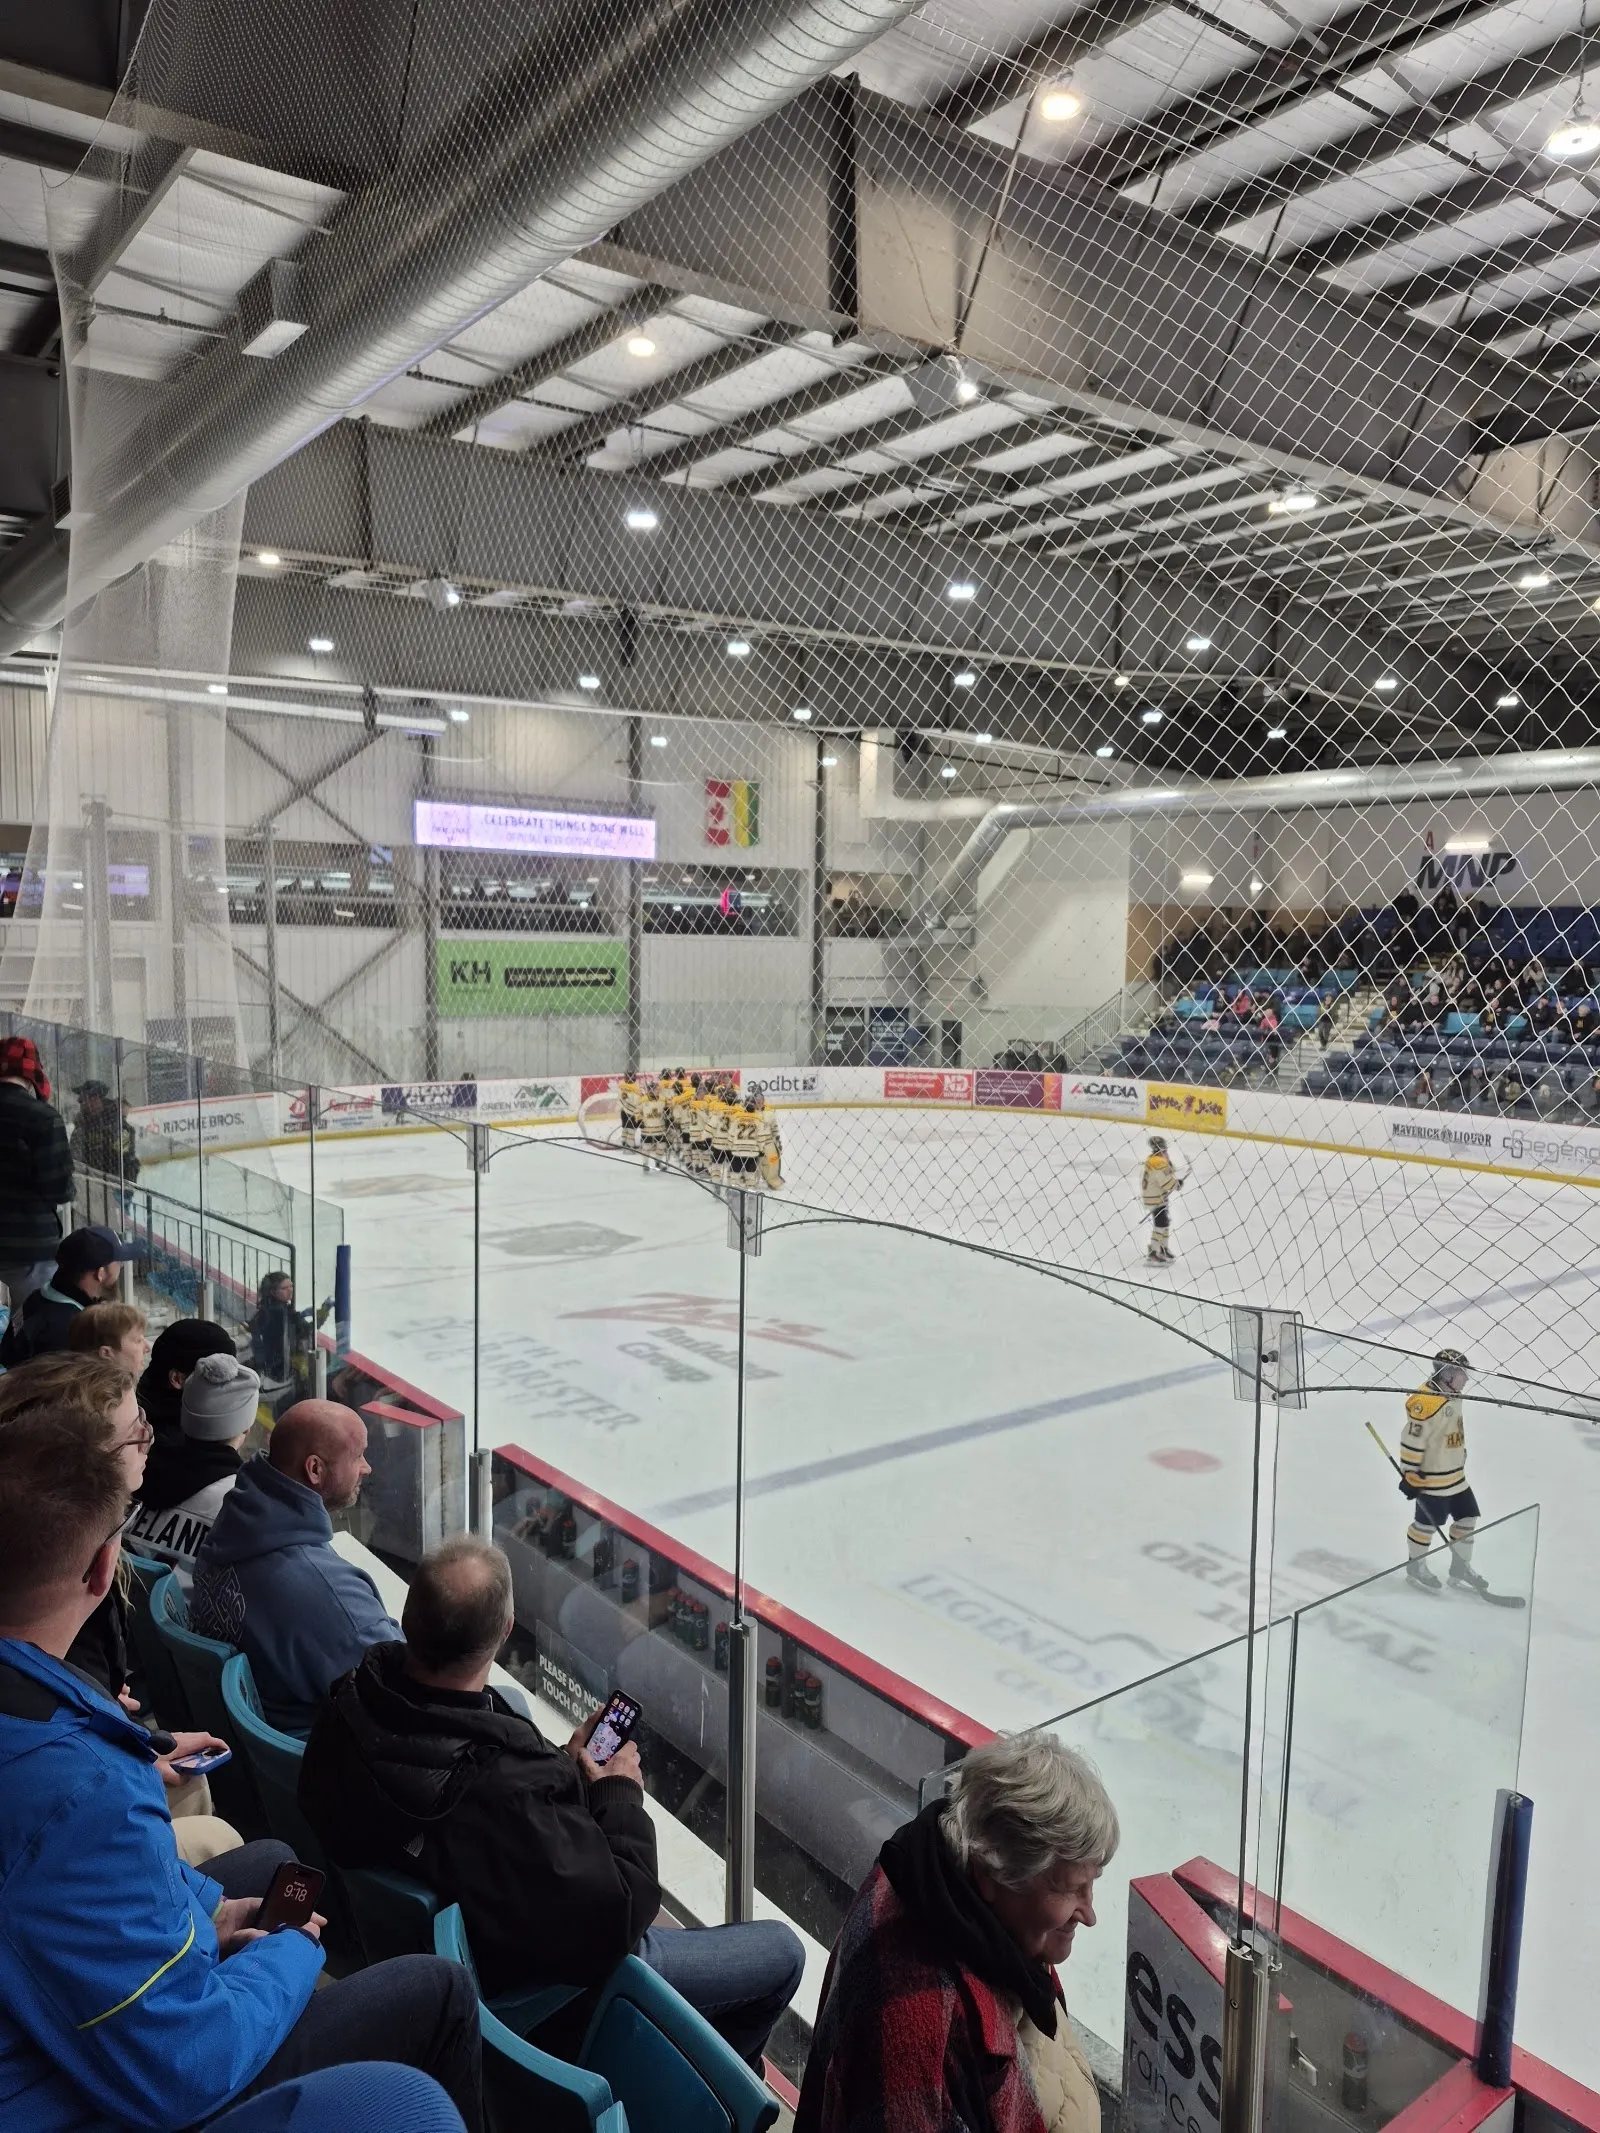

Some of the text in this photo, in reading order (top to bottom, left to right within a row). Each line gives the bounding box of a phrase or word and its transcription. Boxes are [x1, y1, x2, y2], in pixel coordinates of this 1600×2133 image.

[1415, 852, 1517, 889] MNP
[450, 960, 491, 984] KH
[1071, 1081, 1139, 1099] ACADIA
[513, 1100, 537, 1110] VIEW
[163, 1116, 207, 1134] RITCHIE
[737, 1122, 757, 1140] 22
[1392, 1123, 1492, 1148] MAVERICK LIQUOR
[539, 1653, 567, 1687] PLEASE
[568, 1677, 582, 1699] DO
[542, 1677, 588, 1722] TOUCH GLA
[284, 1884, 308, 1902] 9:18
